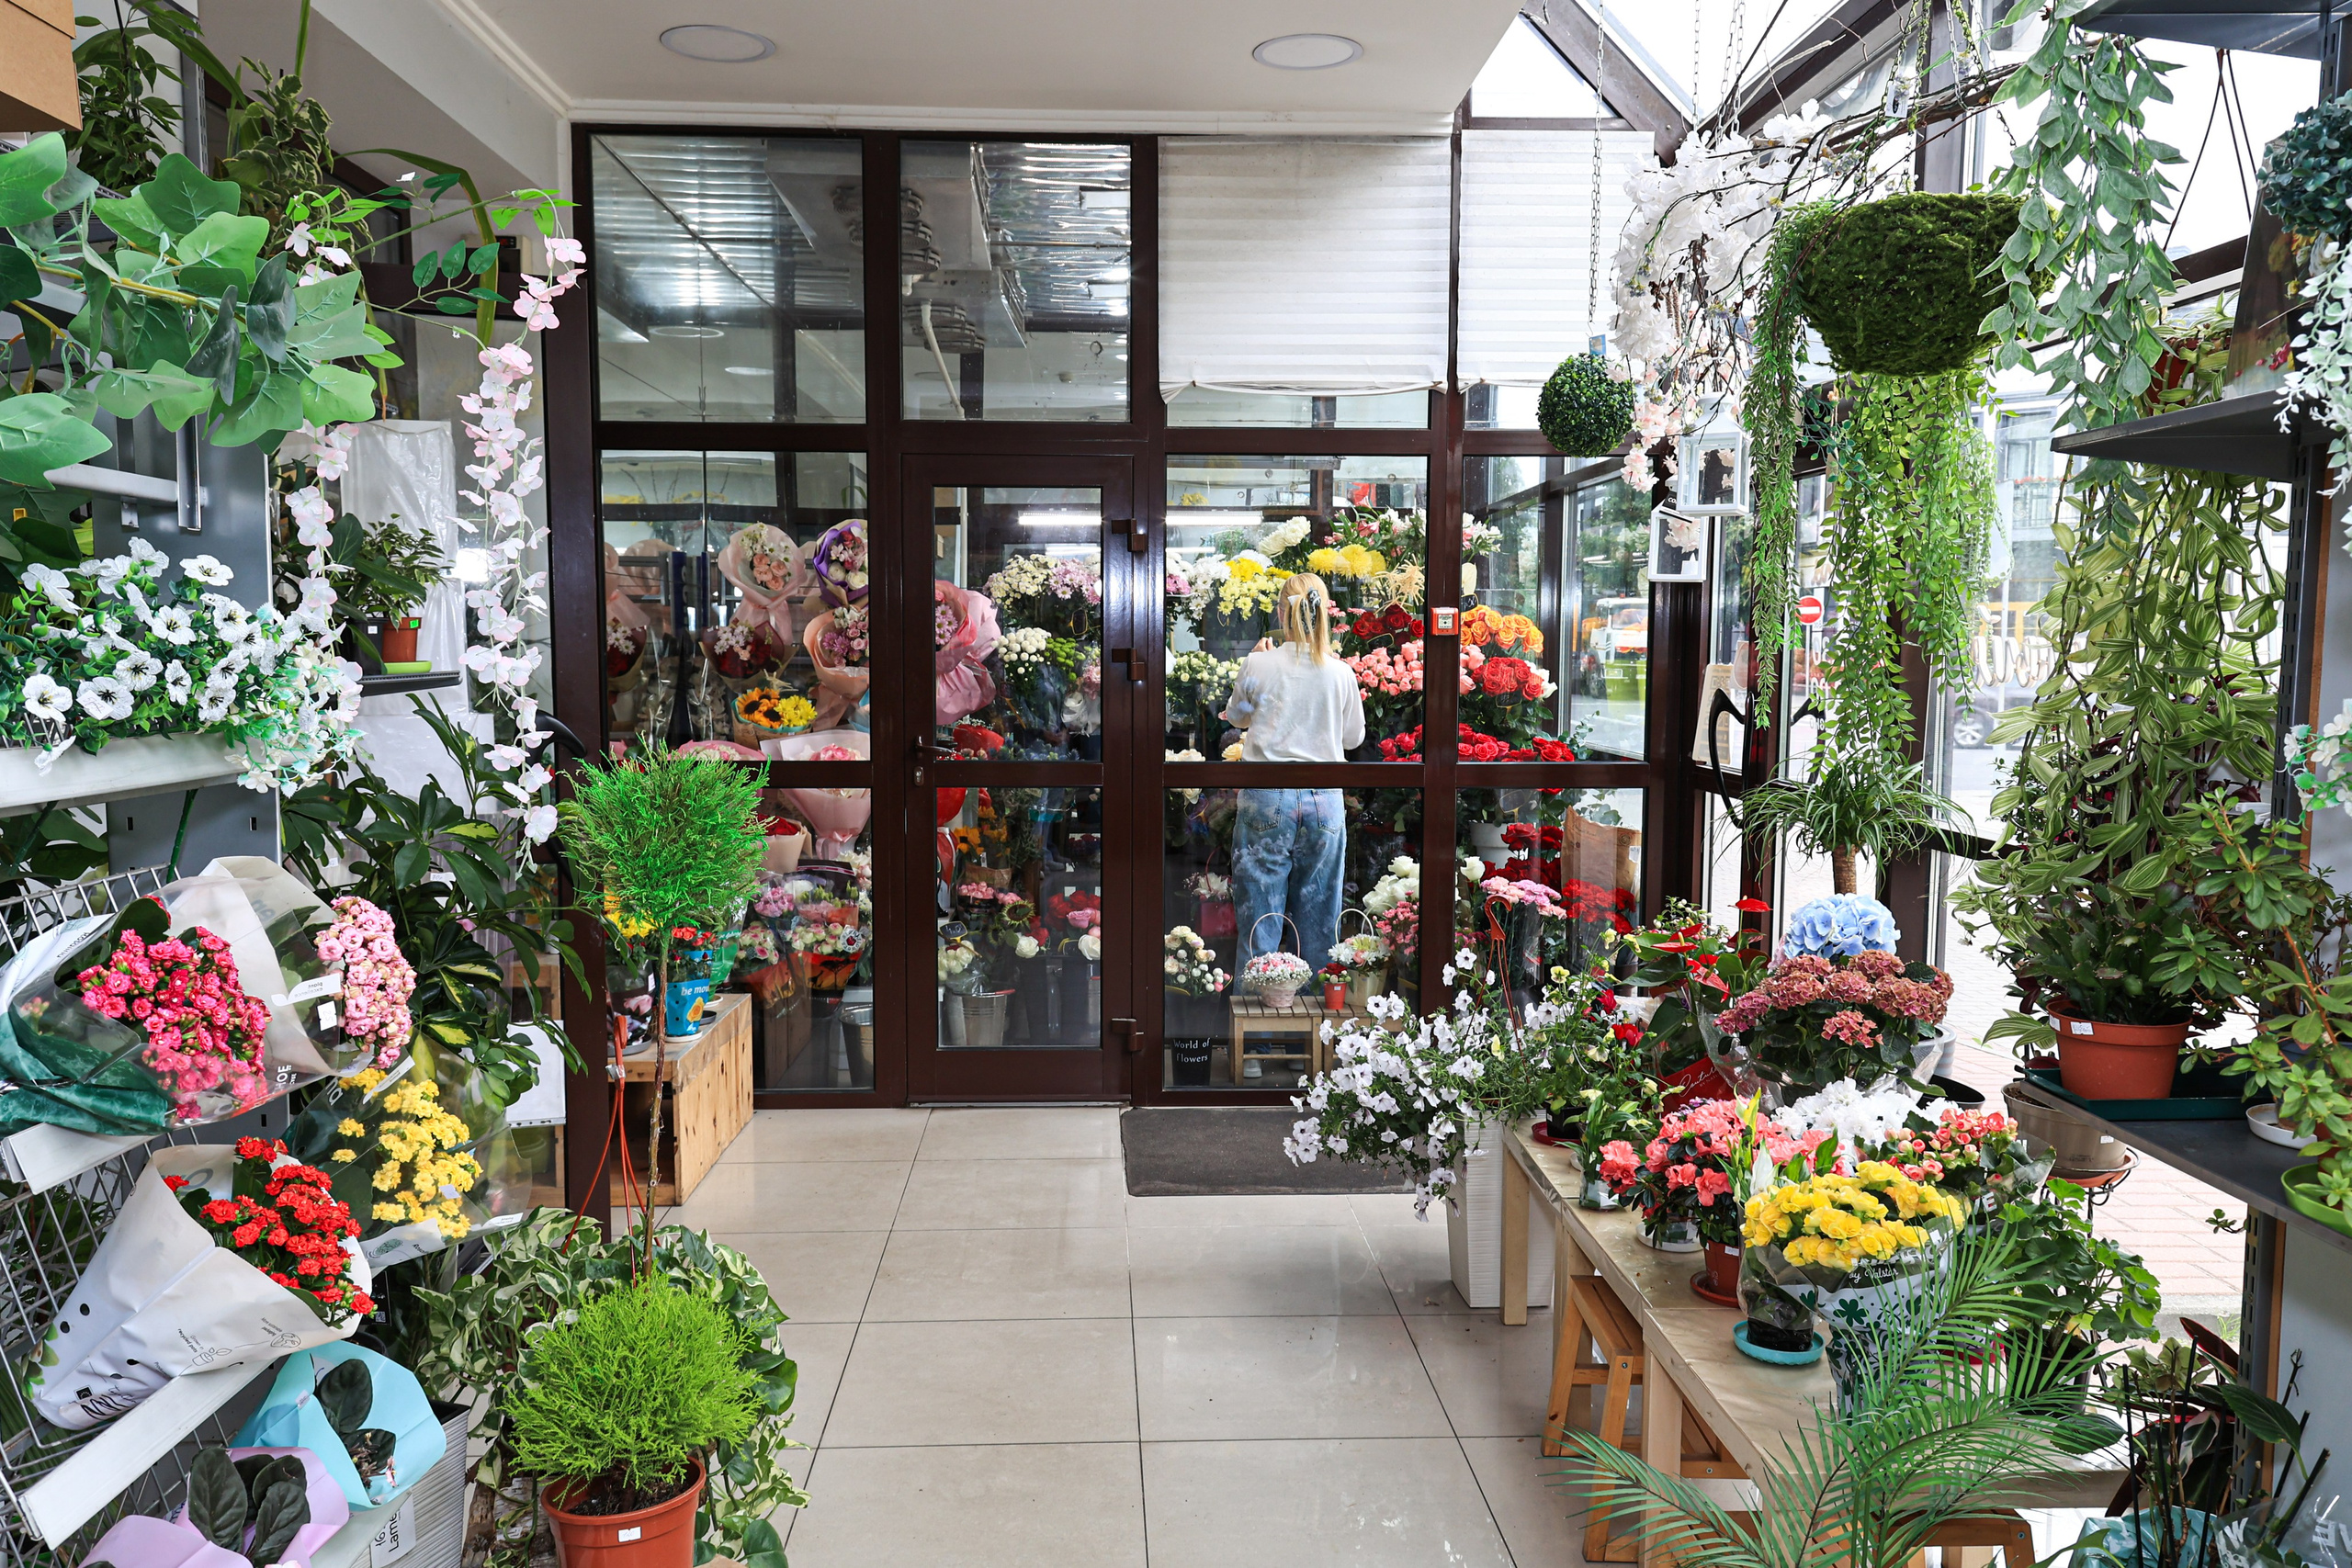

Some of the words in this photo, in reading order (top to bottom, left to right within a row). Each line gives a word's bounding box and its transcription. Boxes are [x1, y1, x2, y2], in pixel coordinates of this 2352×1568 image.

[1173, 1039, 1199, 1049] World
[1202, 1037, 1211, 1048] of
[1176, 1053, 1208, 1063] flowers
